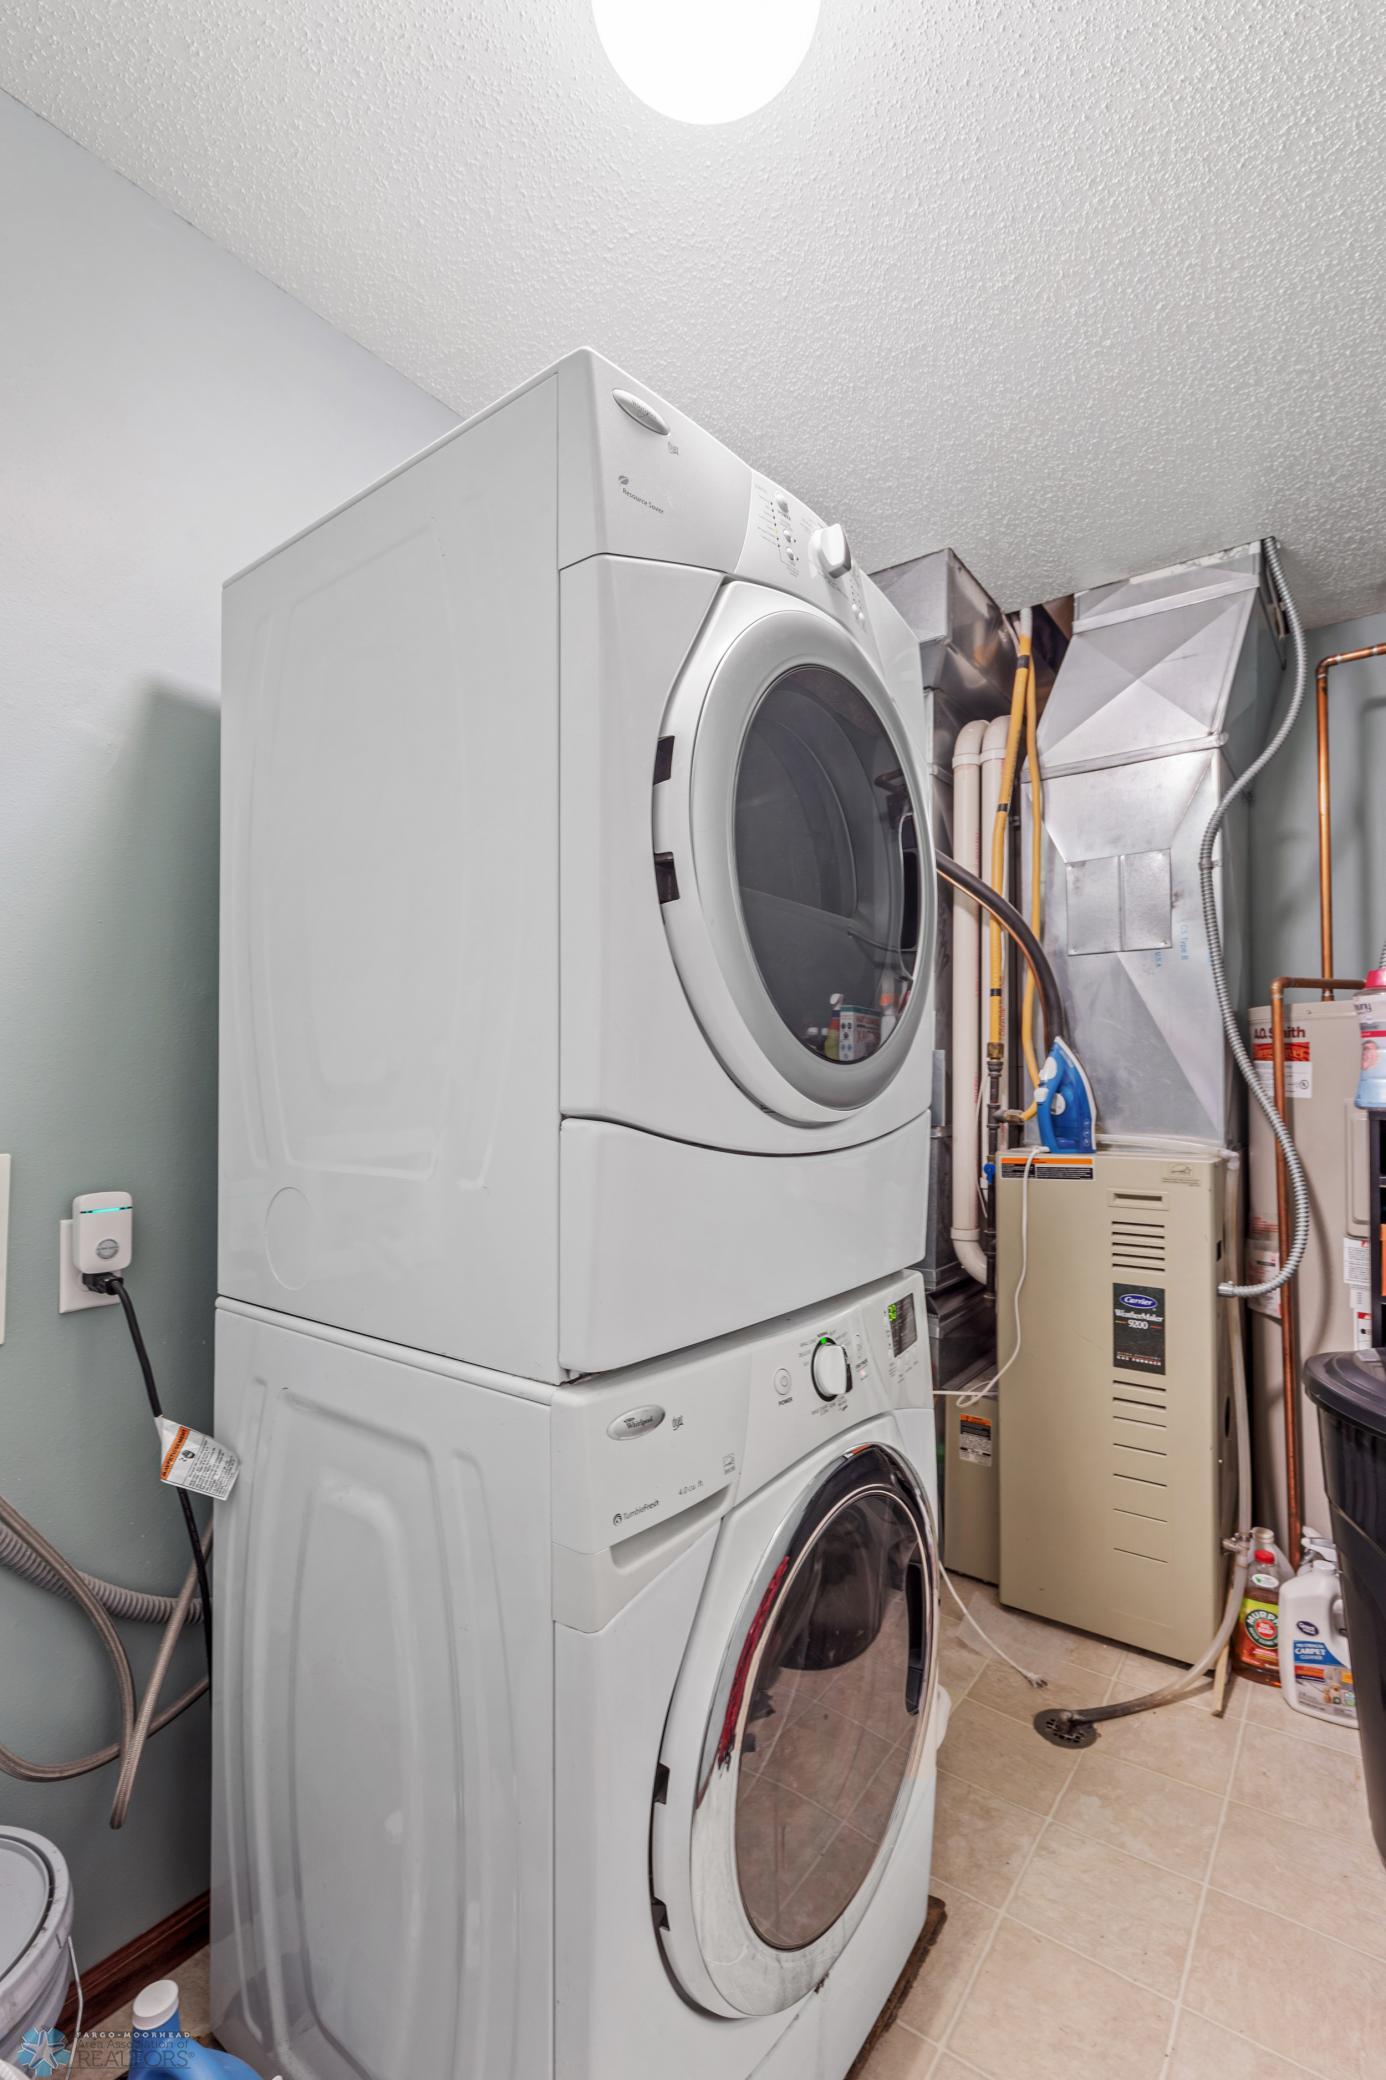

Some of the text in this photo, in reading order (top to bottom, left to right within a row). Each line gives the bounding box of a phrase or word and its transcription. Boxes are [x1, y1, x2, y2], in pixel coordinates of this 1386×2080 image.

[1124, 1296, 1154, 1307] Carrier
[1127, 1319, 1149, 1330] 9200
[1247, 1610, 1279, 1626] MURP
[1295, 1648, 1326, 1657] CARPET
